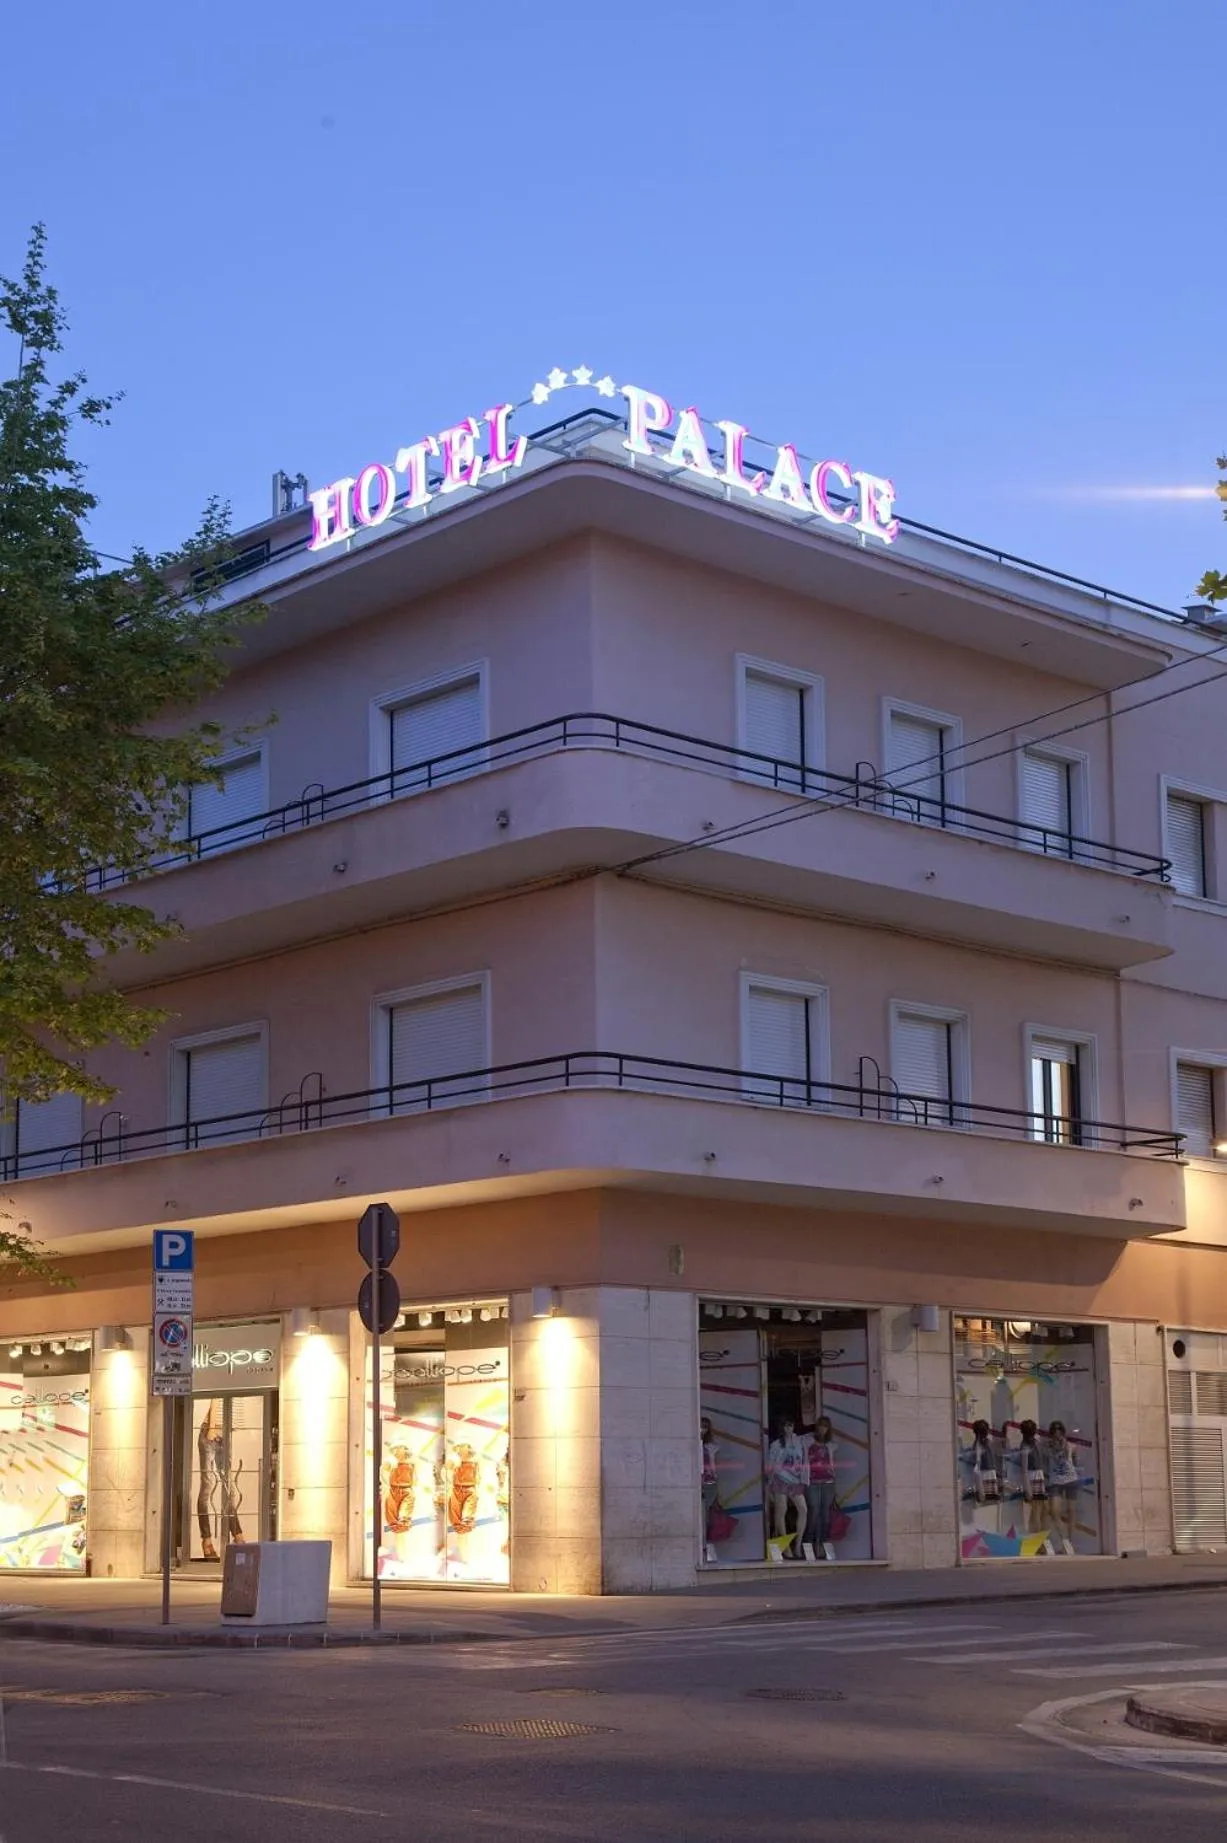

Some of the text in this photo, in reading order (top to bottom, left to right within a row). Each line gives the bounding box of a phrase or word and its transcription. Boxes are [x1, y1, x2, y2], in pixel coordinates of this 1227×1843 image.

[306, 383, 899, 552] HOTEL PALACE
[161, 1234, 187, 1267] P
